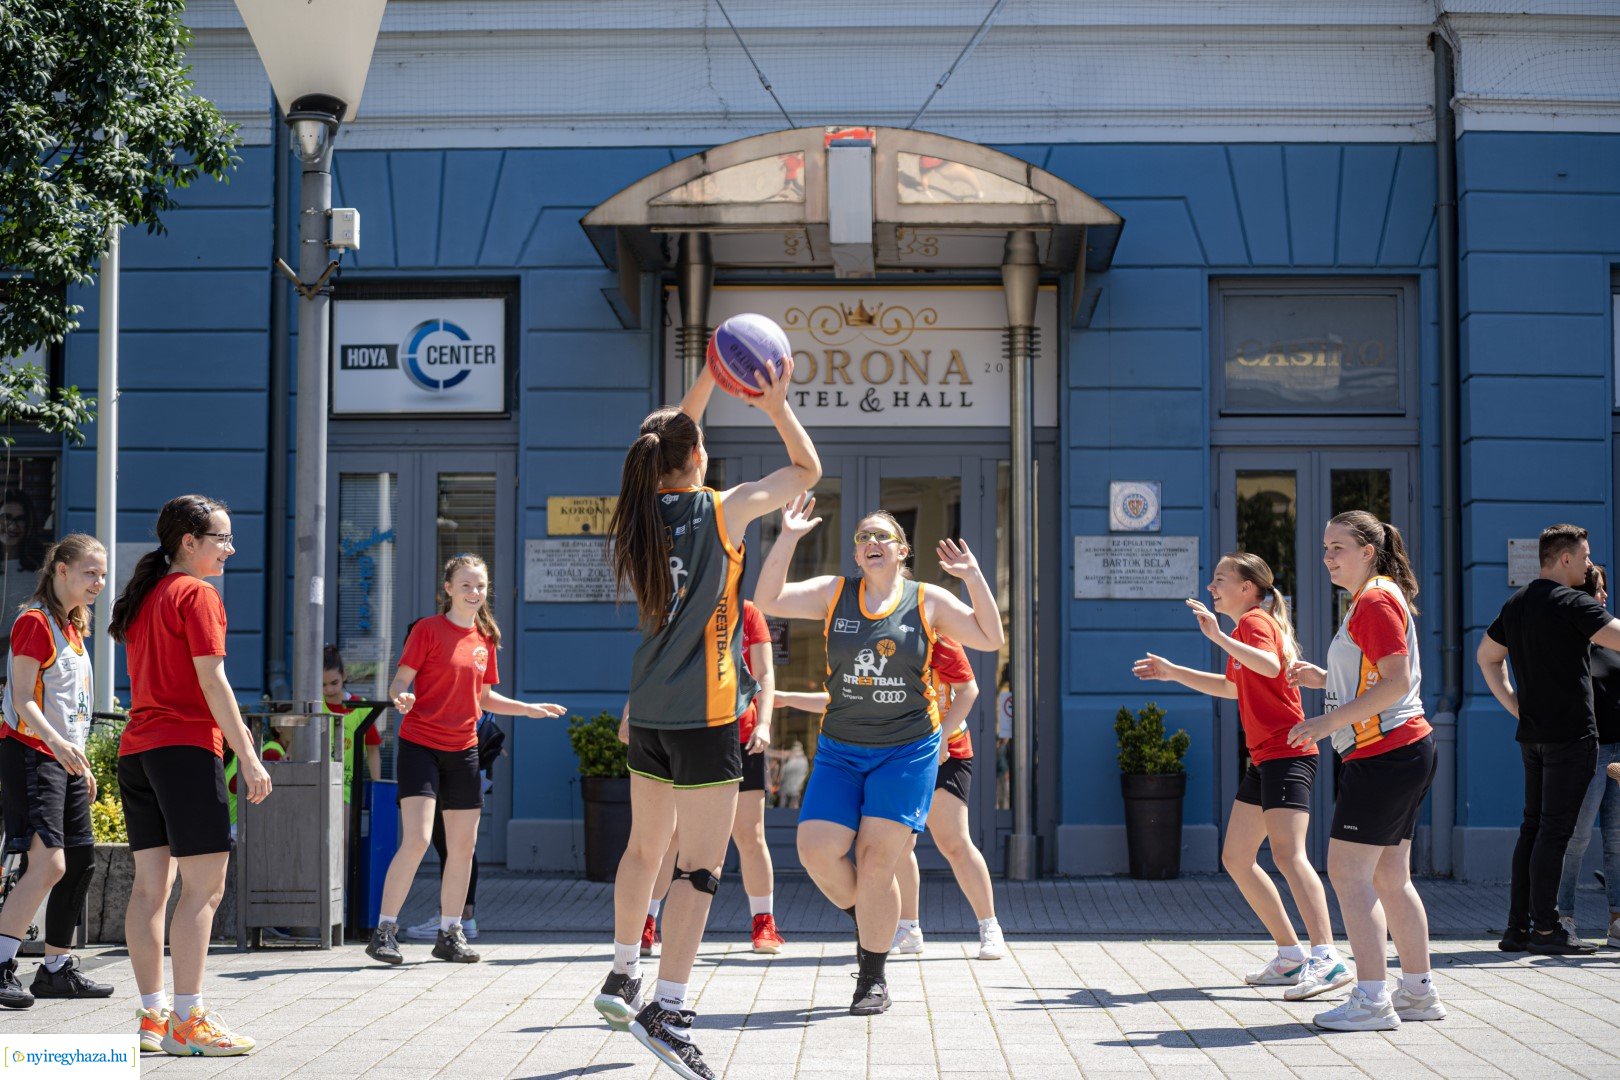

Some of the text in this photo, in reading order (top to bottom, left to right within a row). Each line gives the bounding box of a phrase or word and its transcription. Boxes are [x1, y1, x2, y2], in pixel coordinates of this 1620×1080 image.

[347, 345, 497, 367] HOYA CENTER
[790, 349, 973, 385] ORONA
[860, 387, 886, 413] &
[893, 391, 974, 407] HALL
[560, 506, 611, 515] KORONA
[588, 568, 611, 577] ZOLT
[716, 596, 728, 681] TREETBALL
[843, 673, 907, 686] STREETBALL
